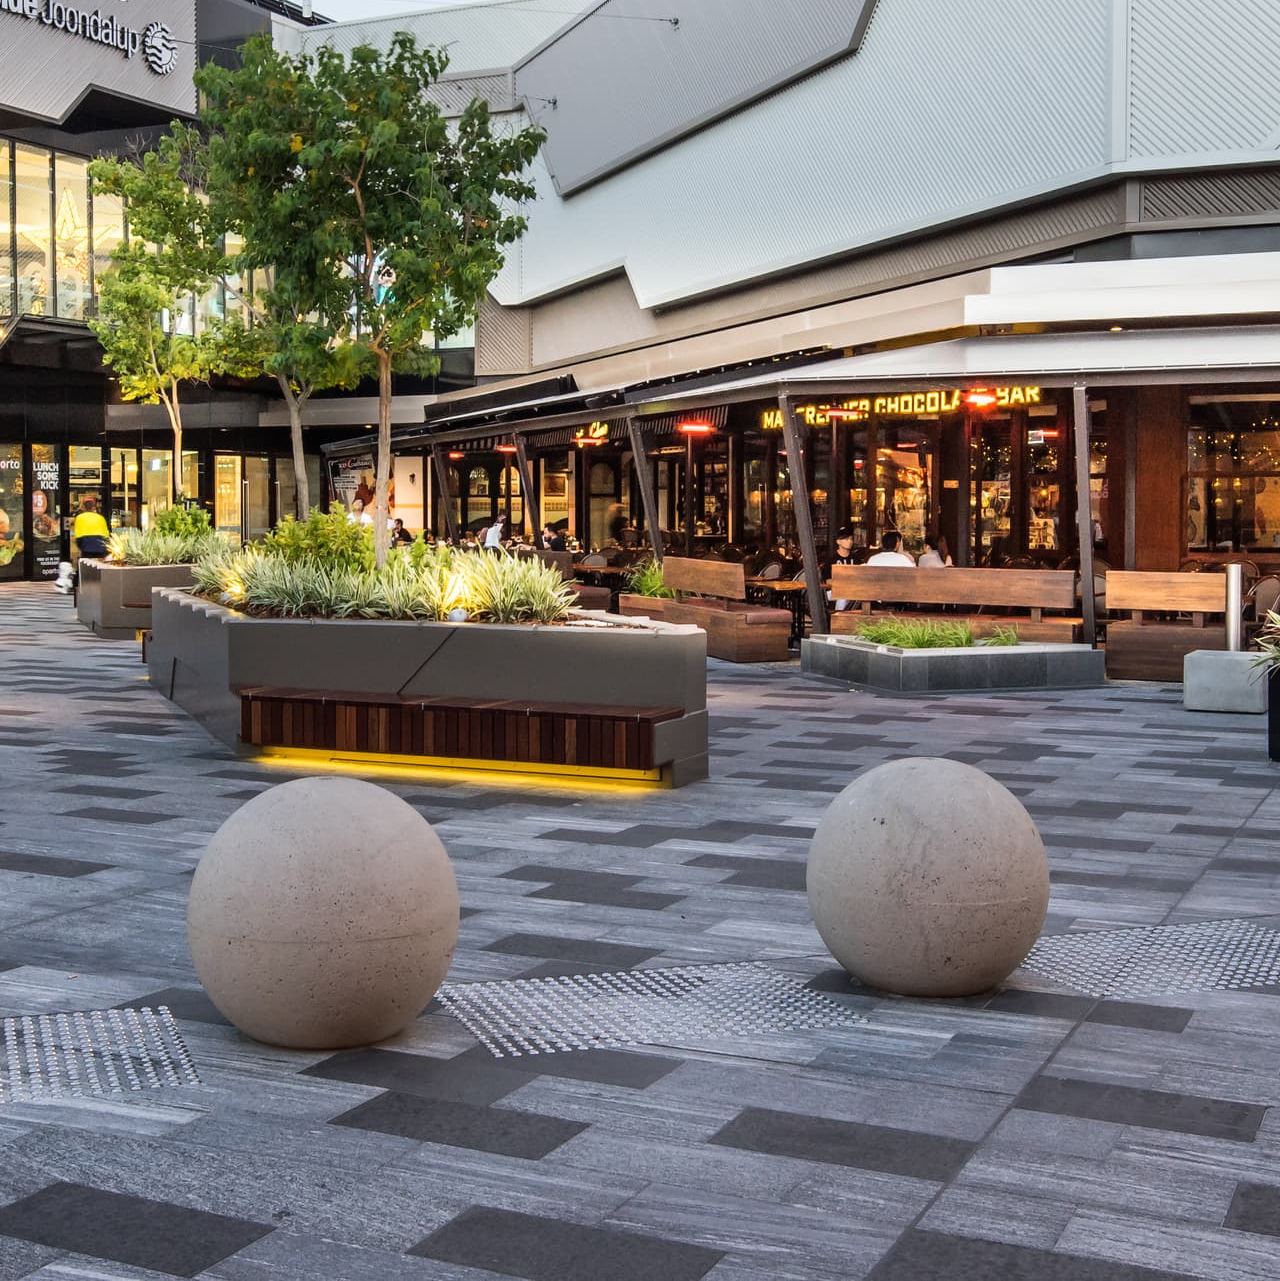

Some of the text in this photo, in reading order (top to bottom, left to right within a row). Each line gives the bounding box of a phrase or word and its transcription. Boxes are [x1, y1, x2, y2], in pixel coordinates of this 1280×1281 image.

[763, 410, 785, 430] MA
[32, 462, 58, 472] LUNCH
[37, 472, 58, 481] SOME
[41, 481, 58, 490] KICK
